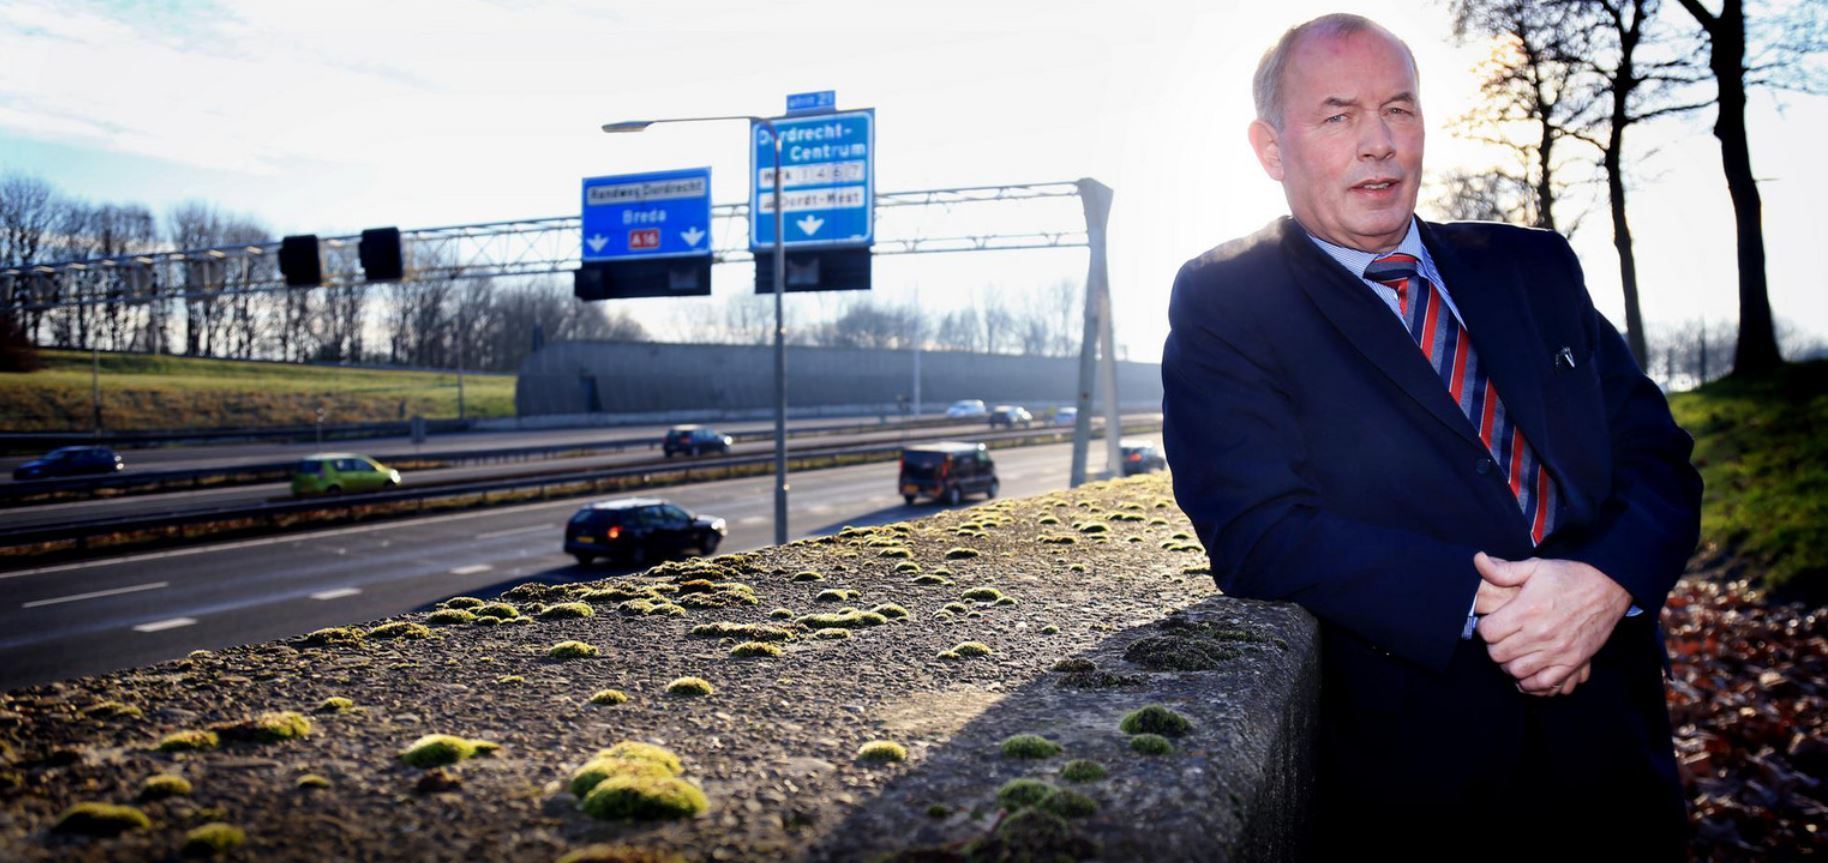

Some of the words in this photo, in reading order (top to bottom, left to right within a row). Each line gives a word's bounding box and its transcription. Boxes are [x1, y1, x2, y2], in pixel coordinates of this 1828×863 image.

[758, 123, 852, 145] Drdrecht-
[790, 143, 866, 161] Centrum
[590, 186, 640, 200] Randweg
[643, 181, 702, 195] Dordrecht
[622, 208, 667, 224] Breda
[631, 232, 657, 246] A16
